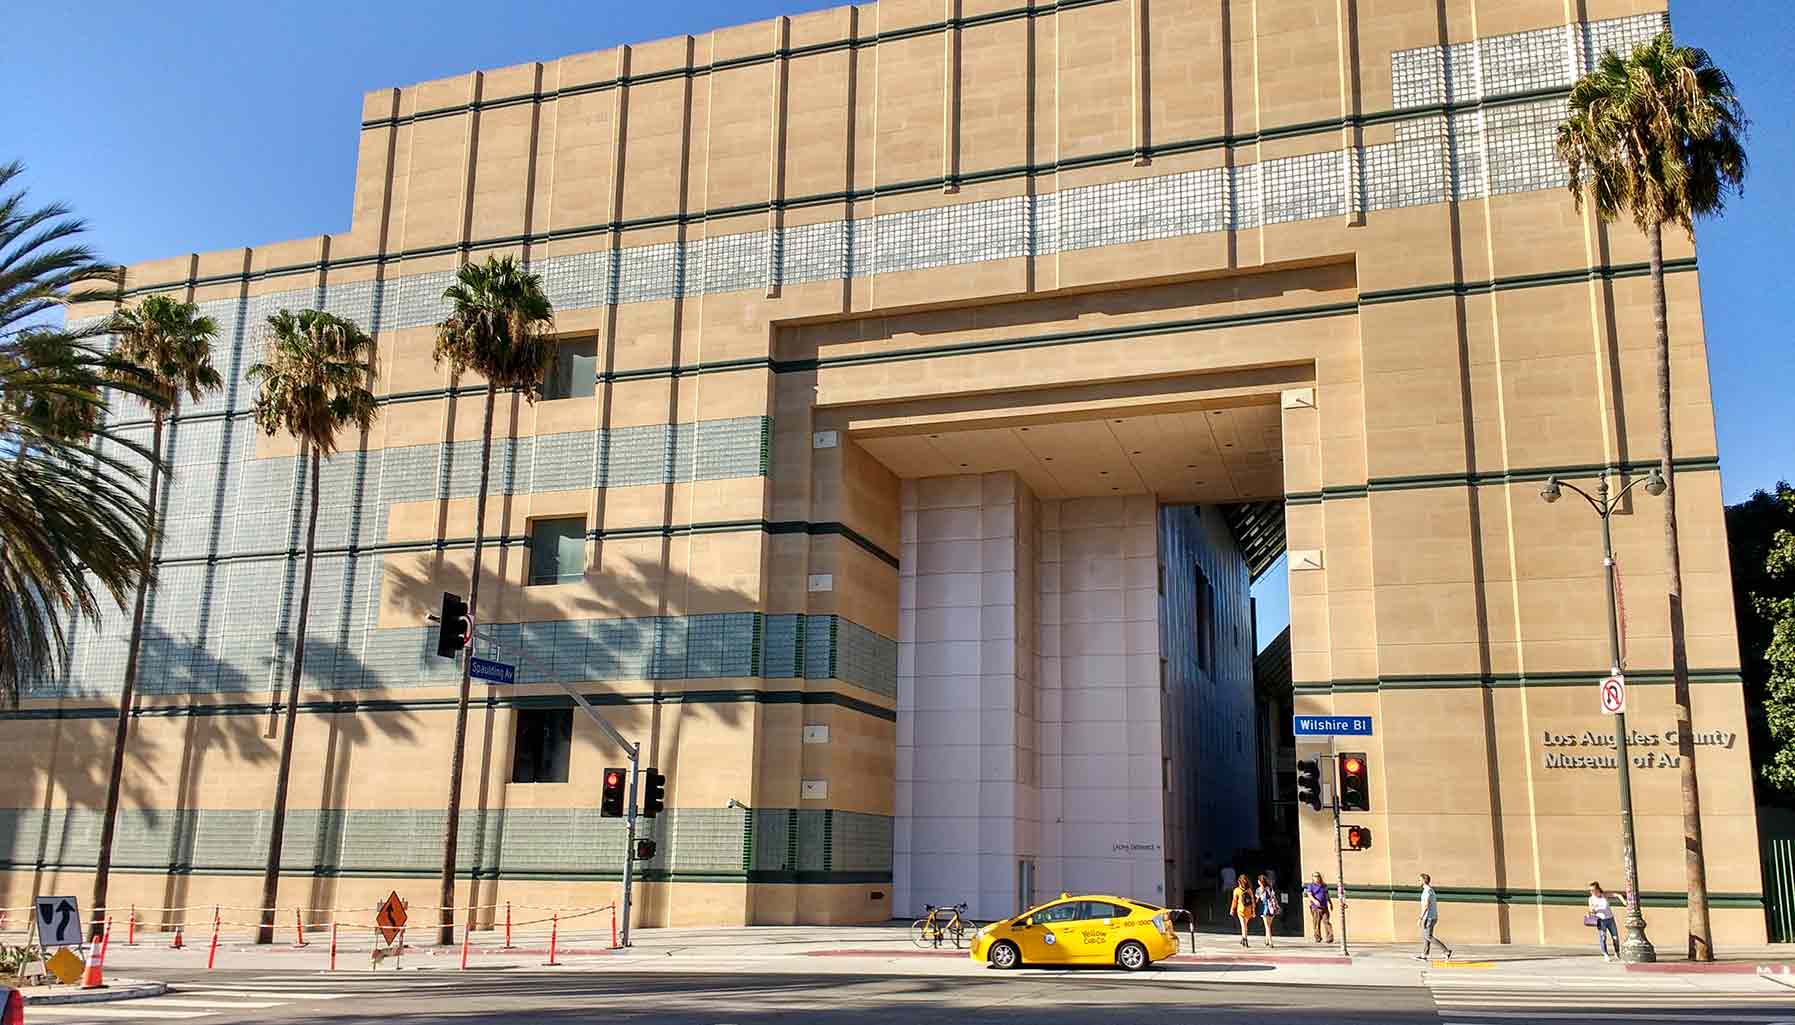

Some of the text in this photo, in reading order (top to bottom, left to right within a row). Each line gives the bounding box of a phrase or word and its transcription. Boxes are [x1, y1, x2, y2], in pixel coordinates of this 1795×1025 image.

[1300, 719, 1366, 731] Wilshire Bl
[1543, 729, 1736, 750] Los Angles Cunty
[1631, 752, 1655, 769] of
[1656, 752, 1680, 769] Ar
[1081, 928, 1107, 938] Yellow
